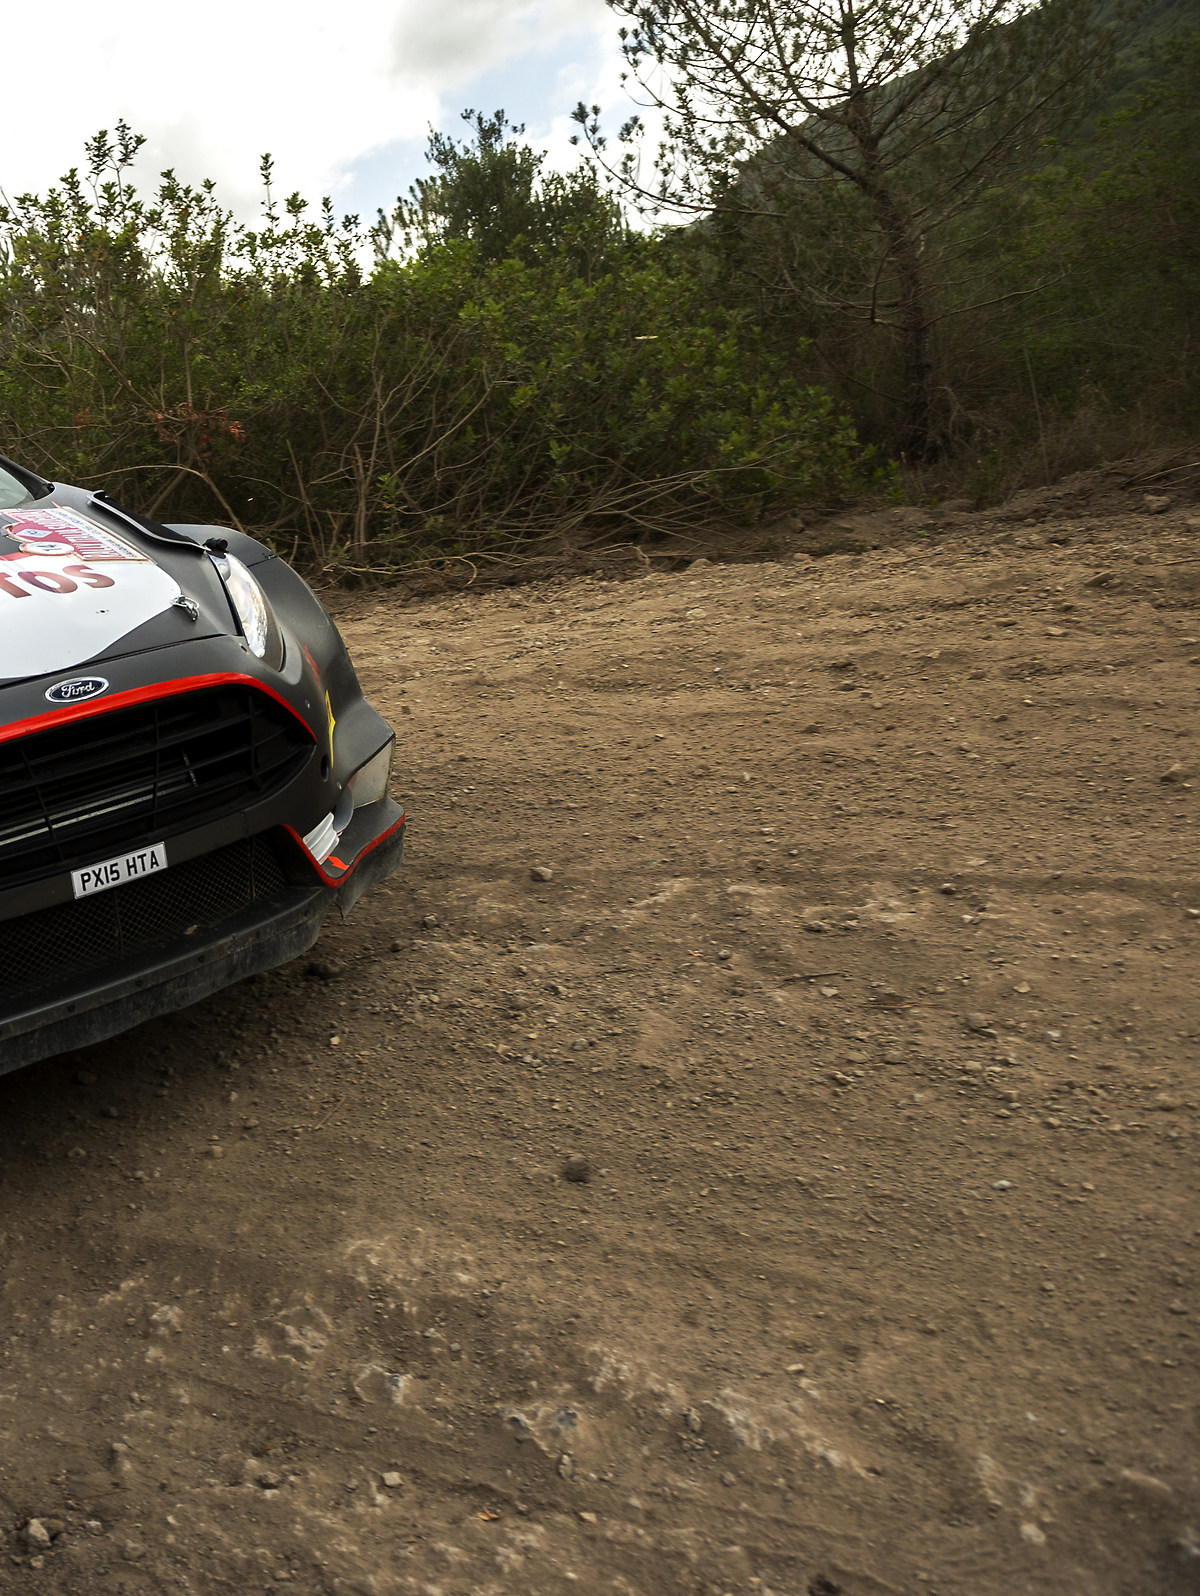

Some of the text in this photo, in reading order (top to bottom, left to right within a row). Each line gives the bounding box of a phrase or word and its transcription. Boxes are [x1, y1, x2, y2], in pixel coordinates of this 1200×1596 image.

[61, 680, 96, 699] Ford
[80, 849, 160, 892] PX15 HTA
